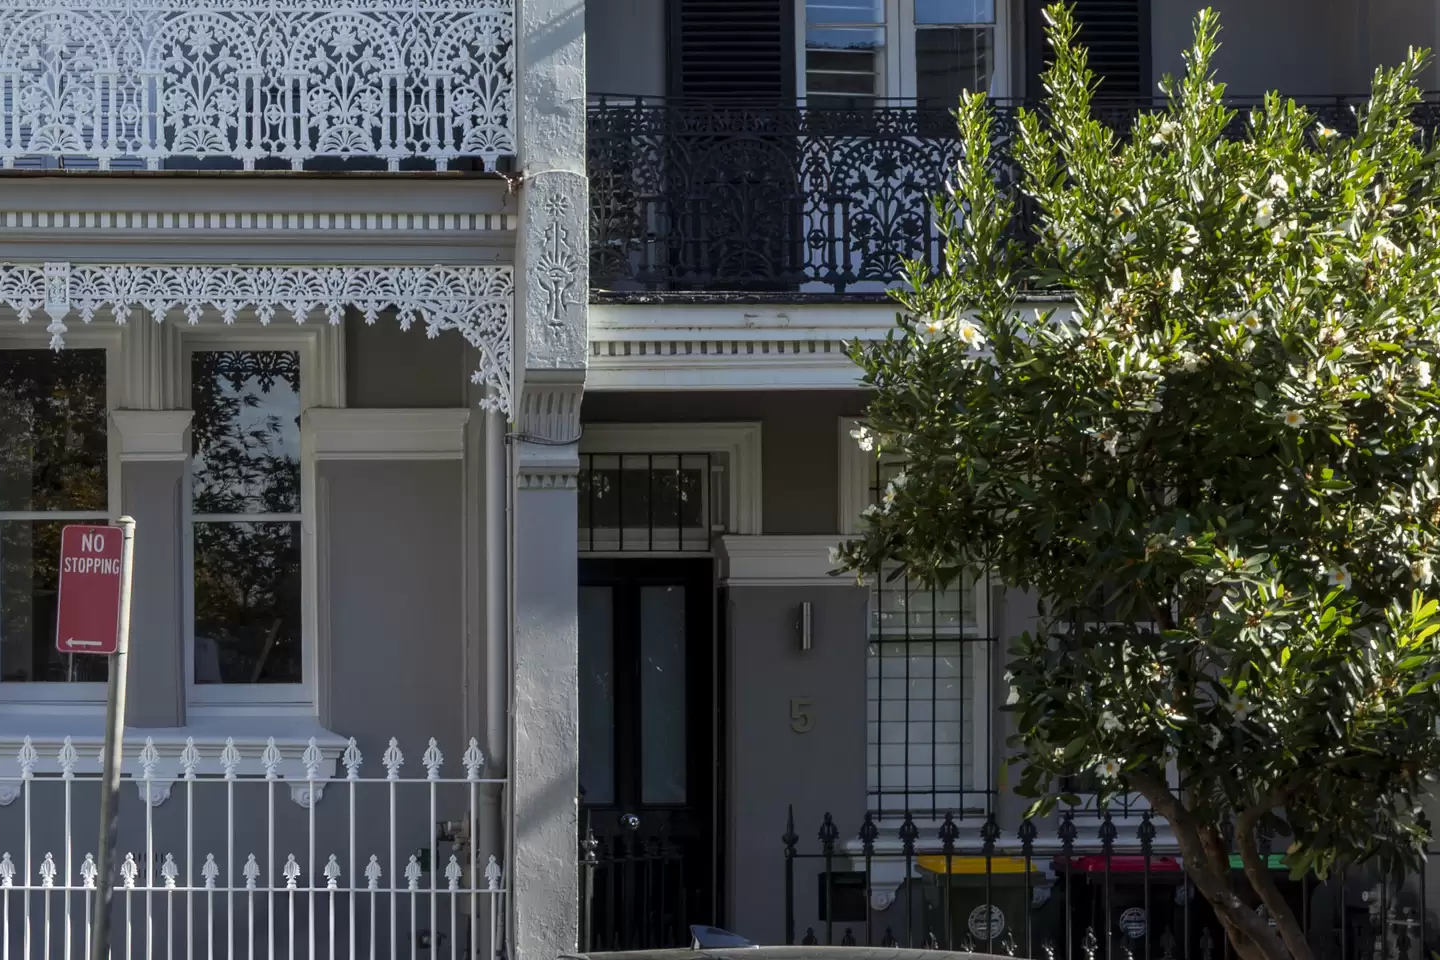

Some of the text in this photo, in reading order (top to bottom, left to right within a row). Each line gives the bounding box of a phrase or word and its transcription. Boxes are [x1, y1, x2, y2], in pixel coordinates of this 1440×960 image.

[81, 533, 105, 553] NO
[64, 556, 120, 575] STOPPING
[790, 697, 816, 734] 5
